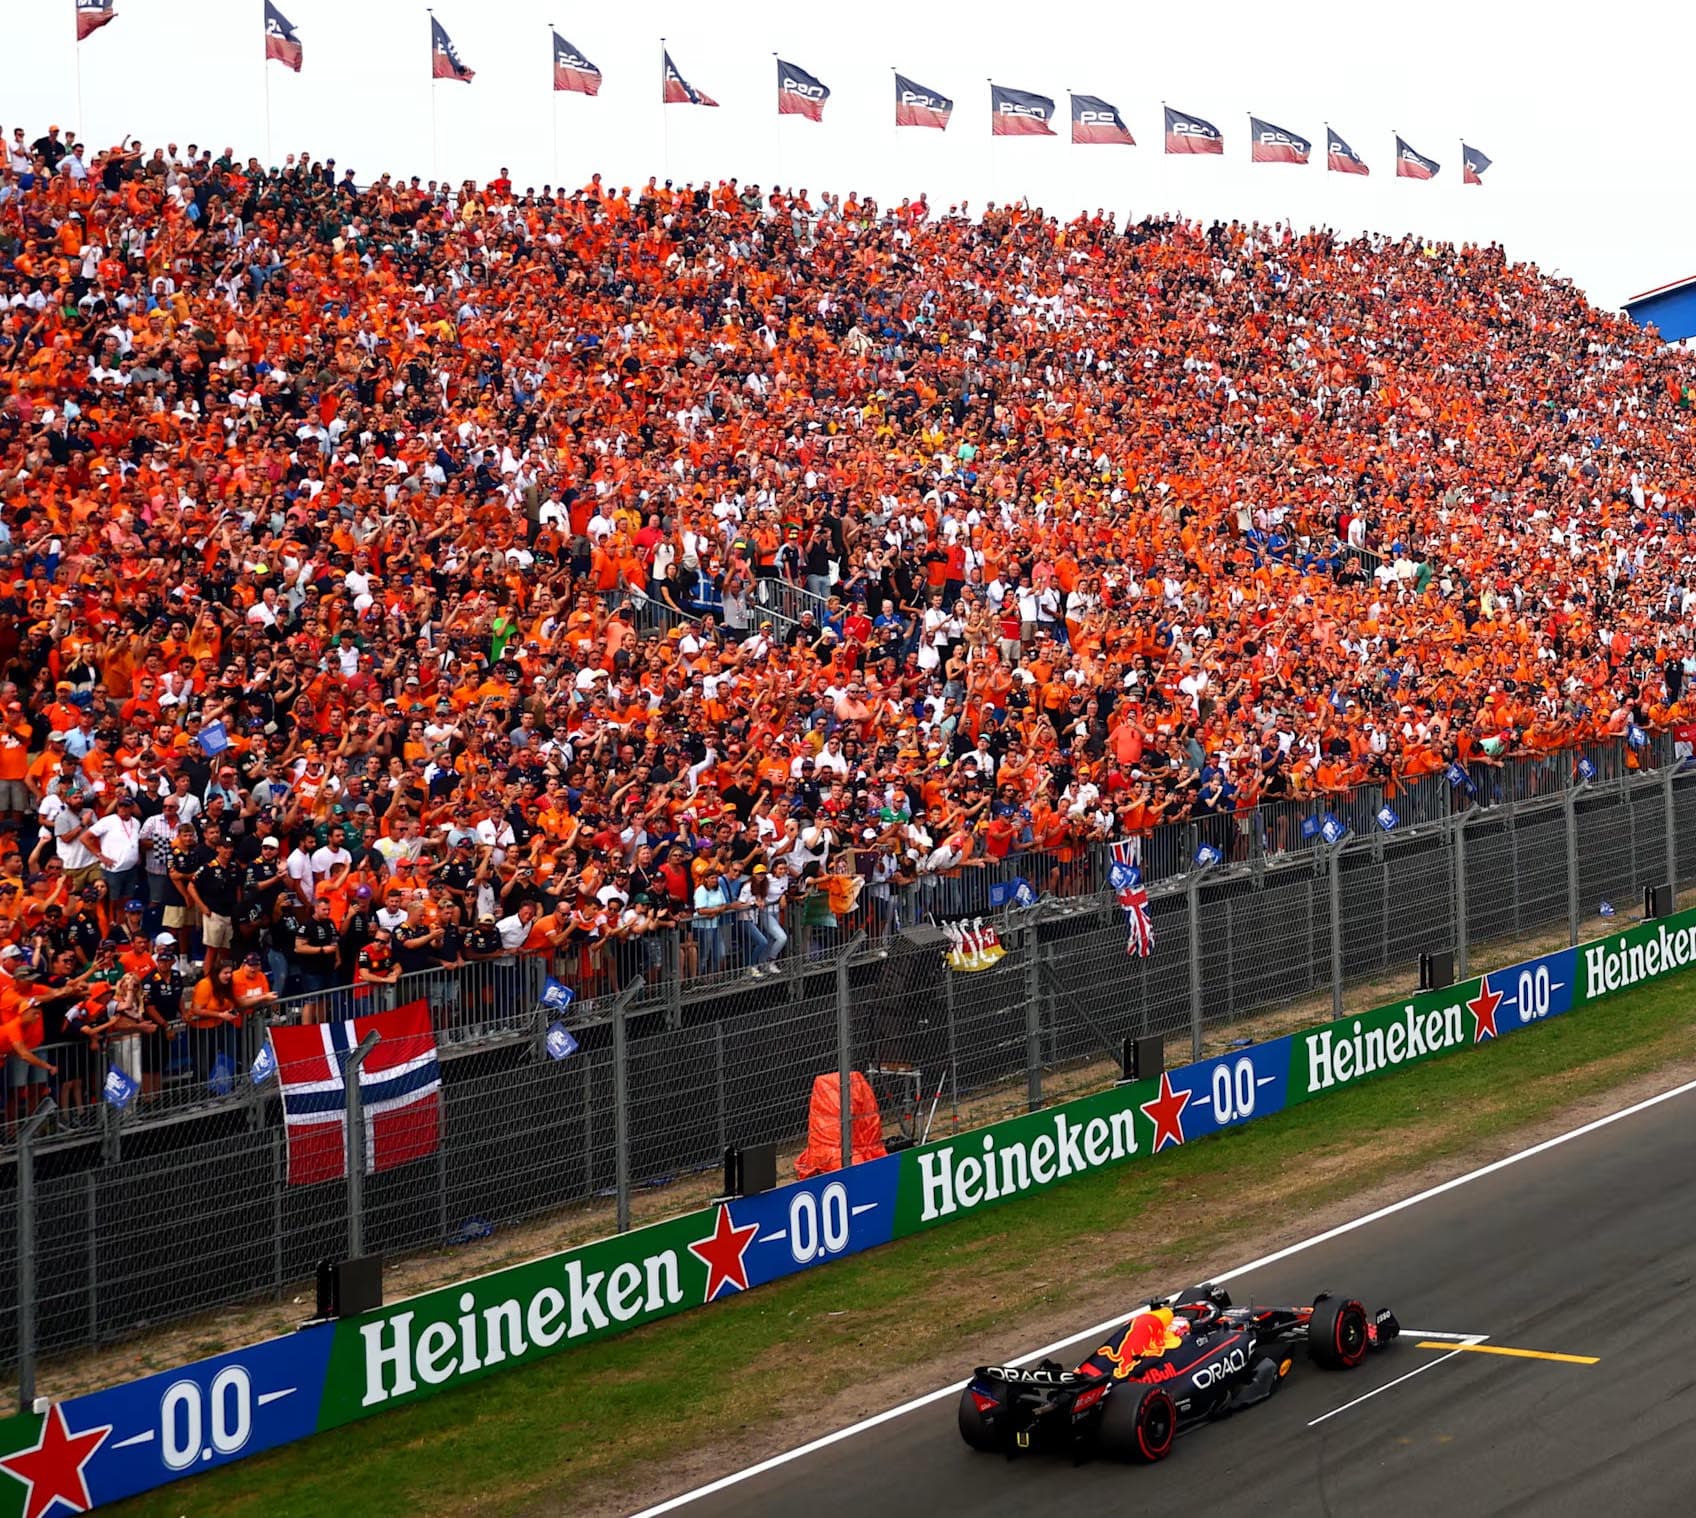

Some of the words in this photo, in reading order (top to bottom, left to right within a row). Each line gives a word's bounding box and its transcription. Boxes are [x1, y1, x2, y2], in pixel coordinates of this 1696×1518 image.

[1305, 1004, 1464, 1092] Heineken
[1518, 964, 1550, 1022] 0.0
[918, 1106, 1137, 1221] Heineken
[1212, 1057, 1255, 1124] 0.0
[361, 1249, 683, 1407] Heineken
[790, 1182, 849, 1263] 0.0
[161, 1365, 251, 1470] 0.0
[987, 1366, 1076, 1384] ORACLE
[1149, 1362, 1177, 1384] Bull
[1191, 1340, 1257, 1390] ORACLE
